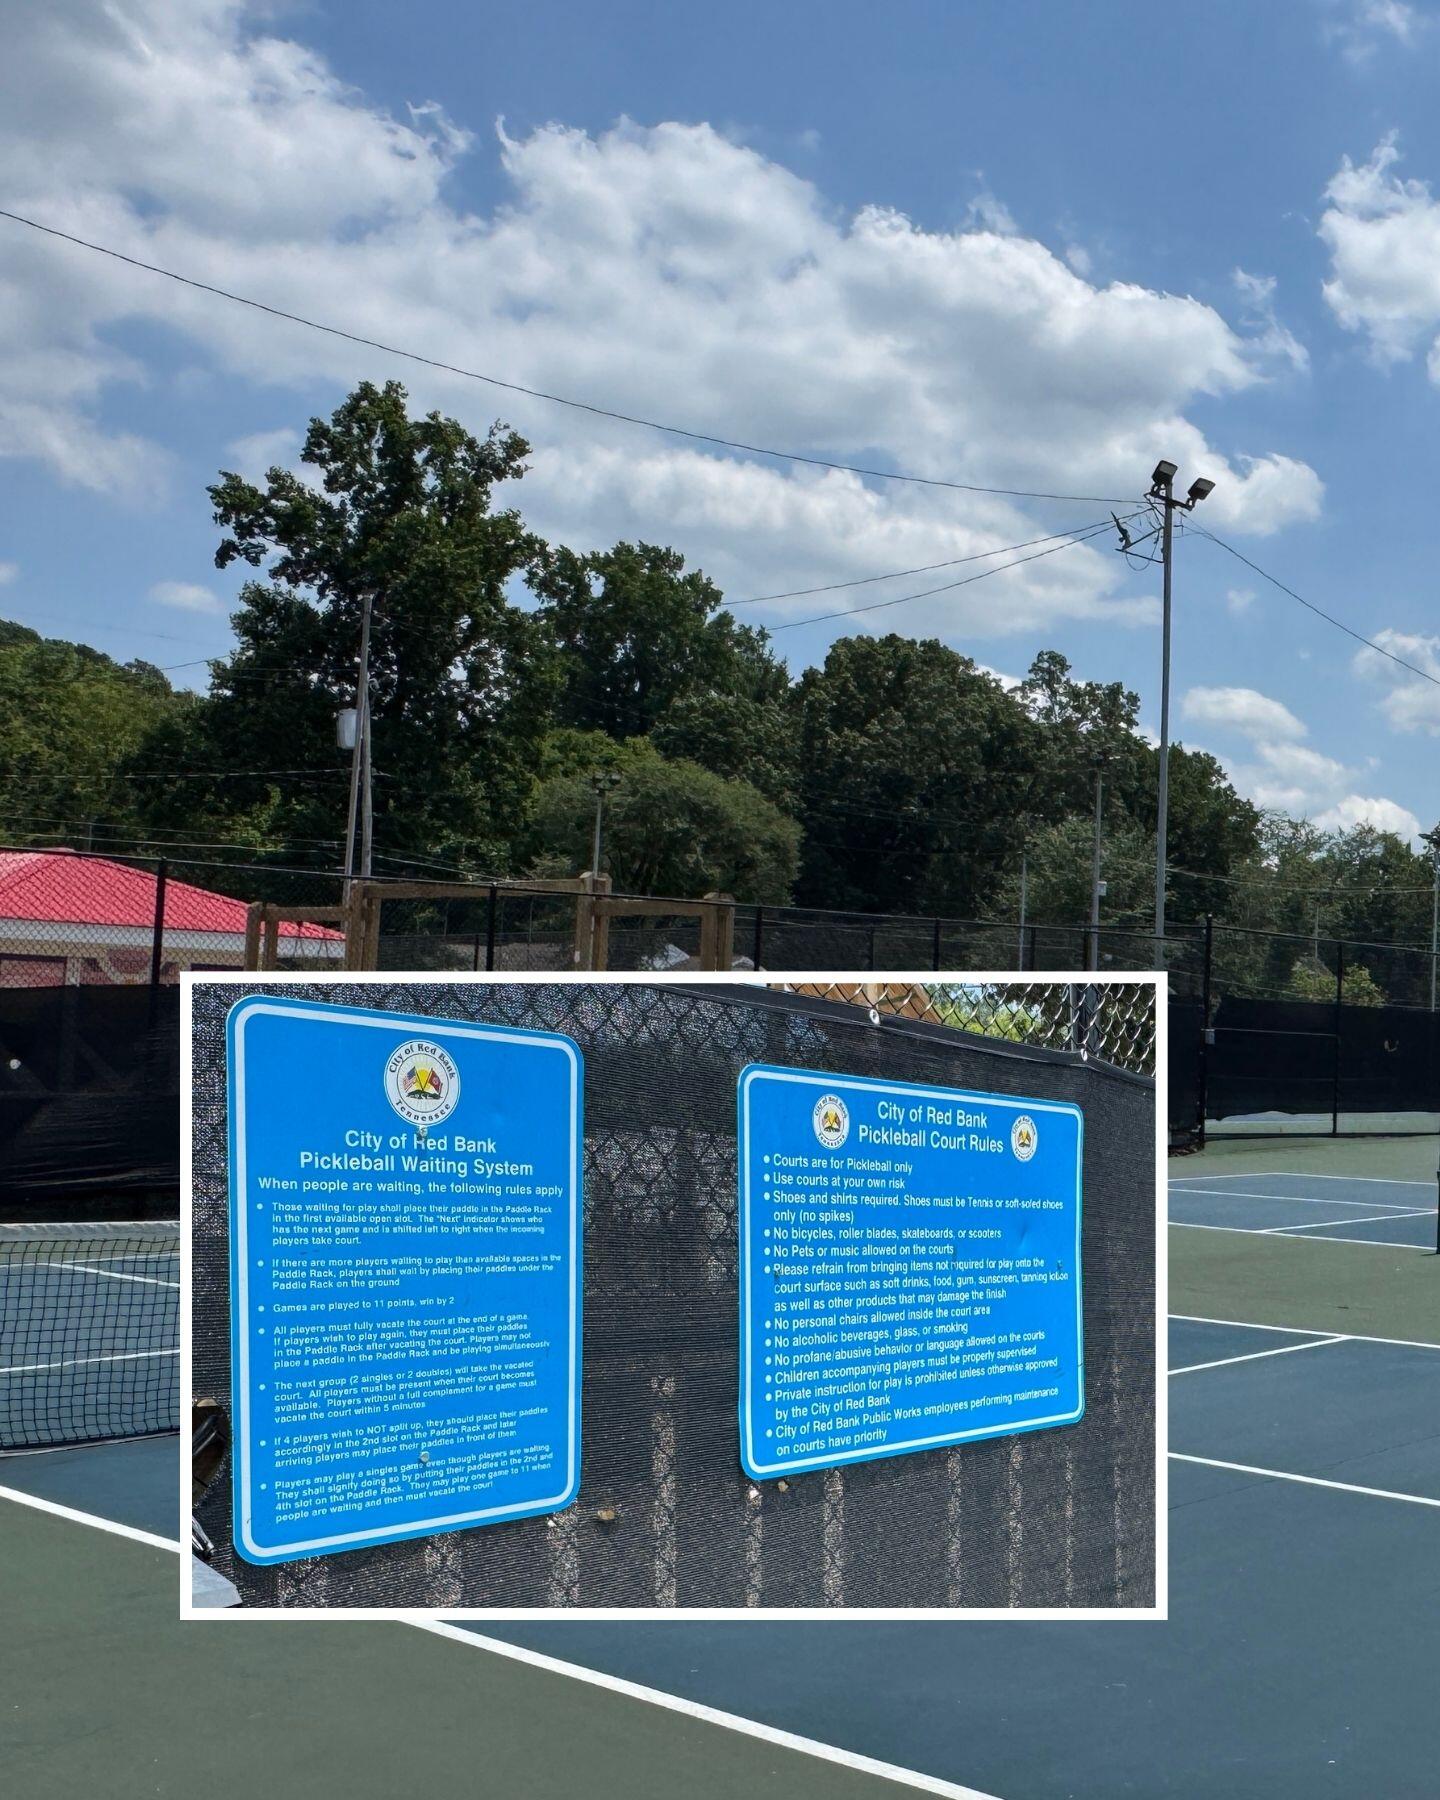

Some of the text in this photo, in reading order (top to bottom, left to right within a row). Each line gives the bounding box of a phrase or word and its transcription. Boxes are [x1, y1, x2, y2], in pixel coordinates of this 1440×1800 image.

[877, 1101, 988, 1128] City of Red Bank
[345, 1130, 383, 1152] City
[389, 1133, 408, 1149] of
[454, 1136, 497, 1153] Bank
[858, 1125, 926, 1146] Pickleball
[930, 1131, 967, 1149] Court
[969, 1134, 1004, 1152] Rules
[300, 1152, 533, 1177] Pickleball Waiting System
[773, 1153, 913, 1174] Courts are for Pickleball only
[258, 1177, 563, 1197] When people are waiting, the following rules apply
[773, 1172, 905, 1189] Use courts at your own risk
[773, 1190, 807, 1203] Shoes
[808, 1192, 828, 1204] and
[830, 1192, 858, 1204] shirts
[860, 1195, 901, 1205] required.
[903, 1194, 931, 1206] Shoes
[932, 1197, 954, 1207] must
[955, 1196, 966, 1207] be
[967, 1196, 994, 1207] Tennis
[994, 1199, 1004, 1208] or
[1042, 1200, 1064, 1209] shoes
[773, 1209, 854, 1224] only (no spikes)
[773, 1227, 789, 1239] No
[791, 1227, 836, 1240] bicycles,
[838, 1227, 864, 1239] roller
[866, 1228, 899, 1238] blades,
[957, 1230, 967, 1238] or
[968, 1229, 1002, 1238] scooters
[773, 1244, 954, 1257] No Pets or music allowed on the courts
[774, 1288, 1007, 1312] as well as other products that may damage the finish
[773, 1306, 991, 1329] No personal chairs allowed inside the court area
[773, 1335, 790, 1348] No
[792, 1332, 839, 1346] alcoholic
[922, 1326, 932, 1335] or
[933, 1322, 969, 1334] smoking
[774, 1353, 790, 1366] No
[874, 1343, 913, 1356] behavior
[915, 1343, 925, 1352] or
[926, 1339, 965, 1352] language
[965, 1335, 996, 1346] allowed
[997, 1335, 1008, 1343] on
[1009, 1333, 1022, 1342] the
[1022, 1331, 1046, 1341] courts
[774, 1346, 1037, 1384] Children accompanying players must be properly supervised
[774, 1359, 1058, 1401] Private instruction for play is prohibited unless otherwise approved
[774, 1425, 797, 1438] City
[799, 1421, 810, 1434] of
[812, 1419, 833, 1432] Red
[835, 1416, 860, 1429] Bank
[862, 1411, 892, 1424] Public
[893, 1407, 922, 1419] Works
[923, 1401, 969, 1415] employees
[970, 1394, 1013, 1409] performing
[775, 1394, 891, 1422] by the City of Red Bank
[776, 1428, 888, 1456] on courts have priority
